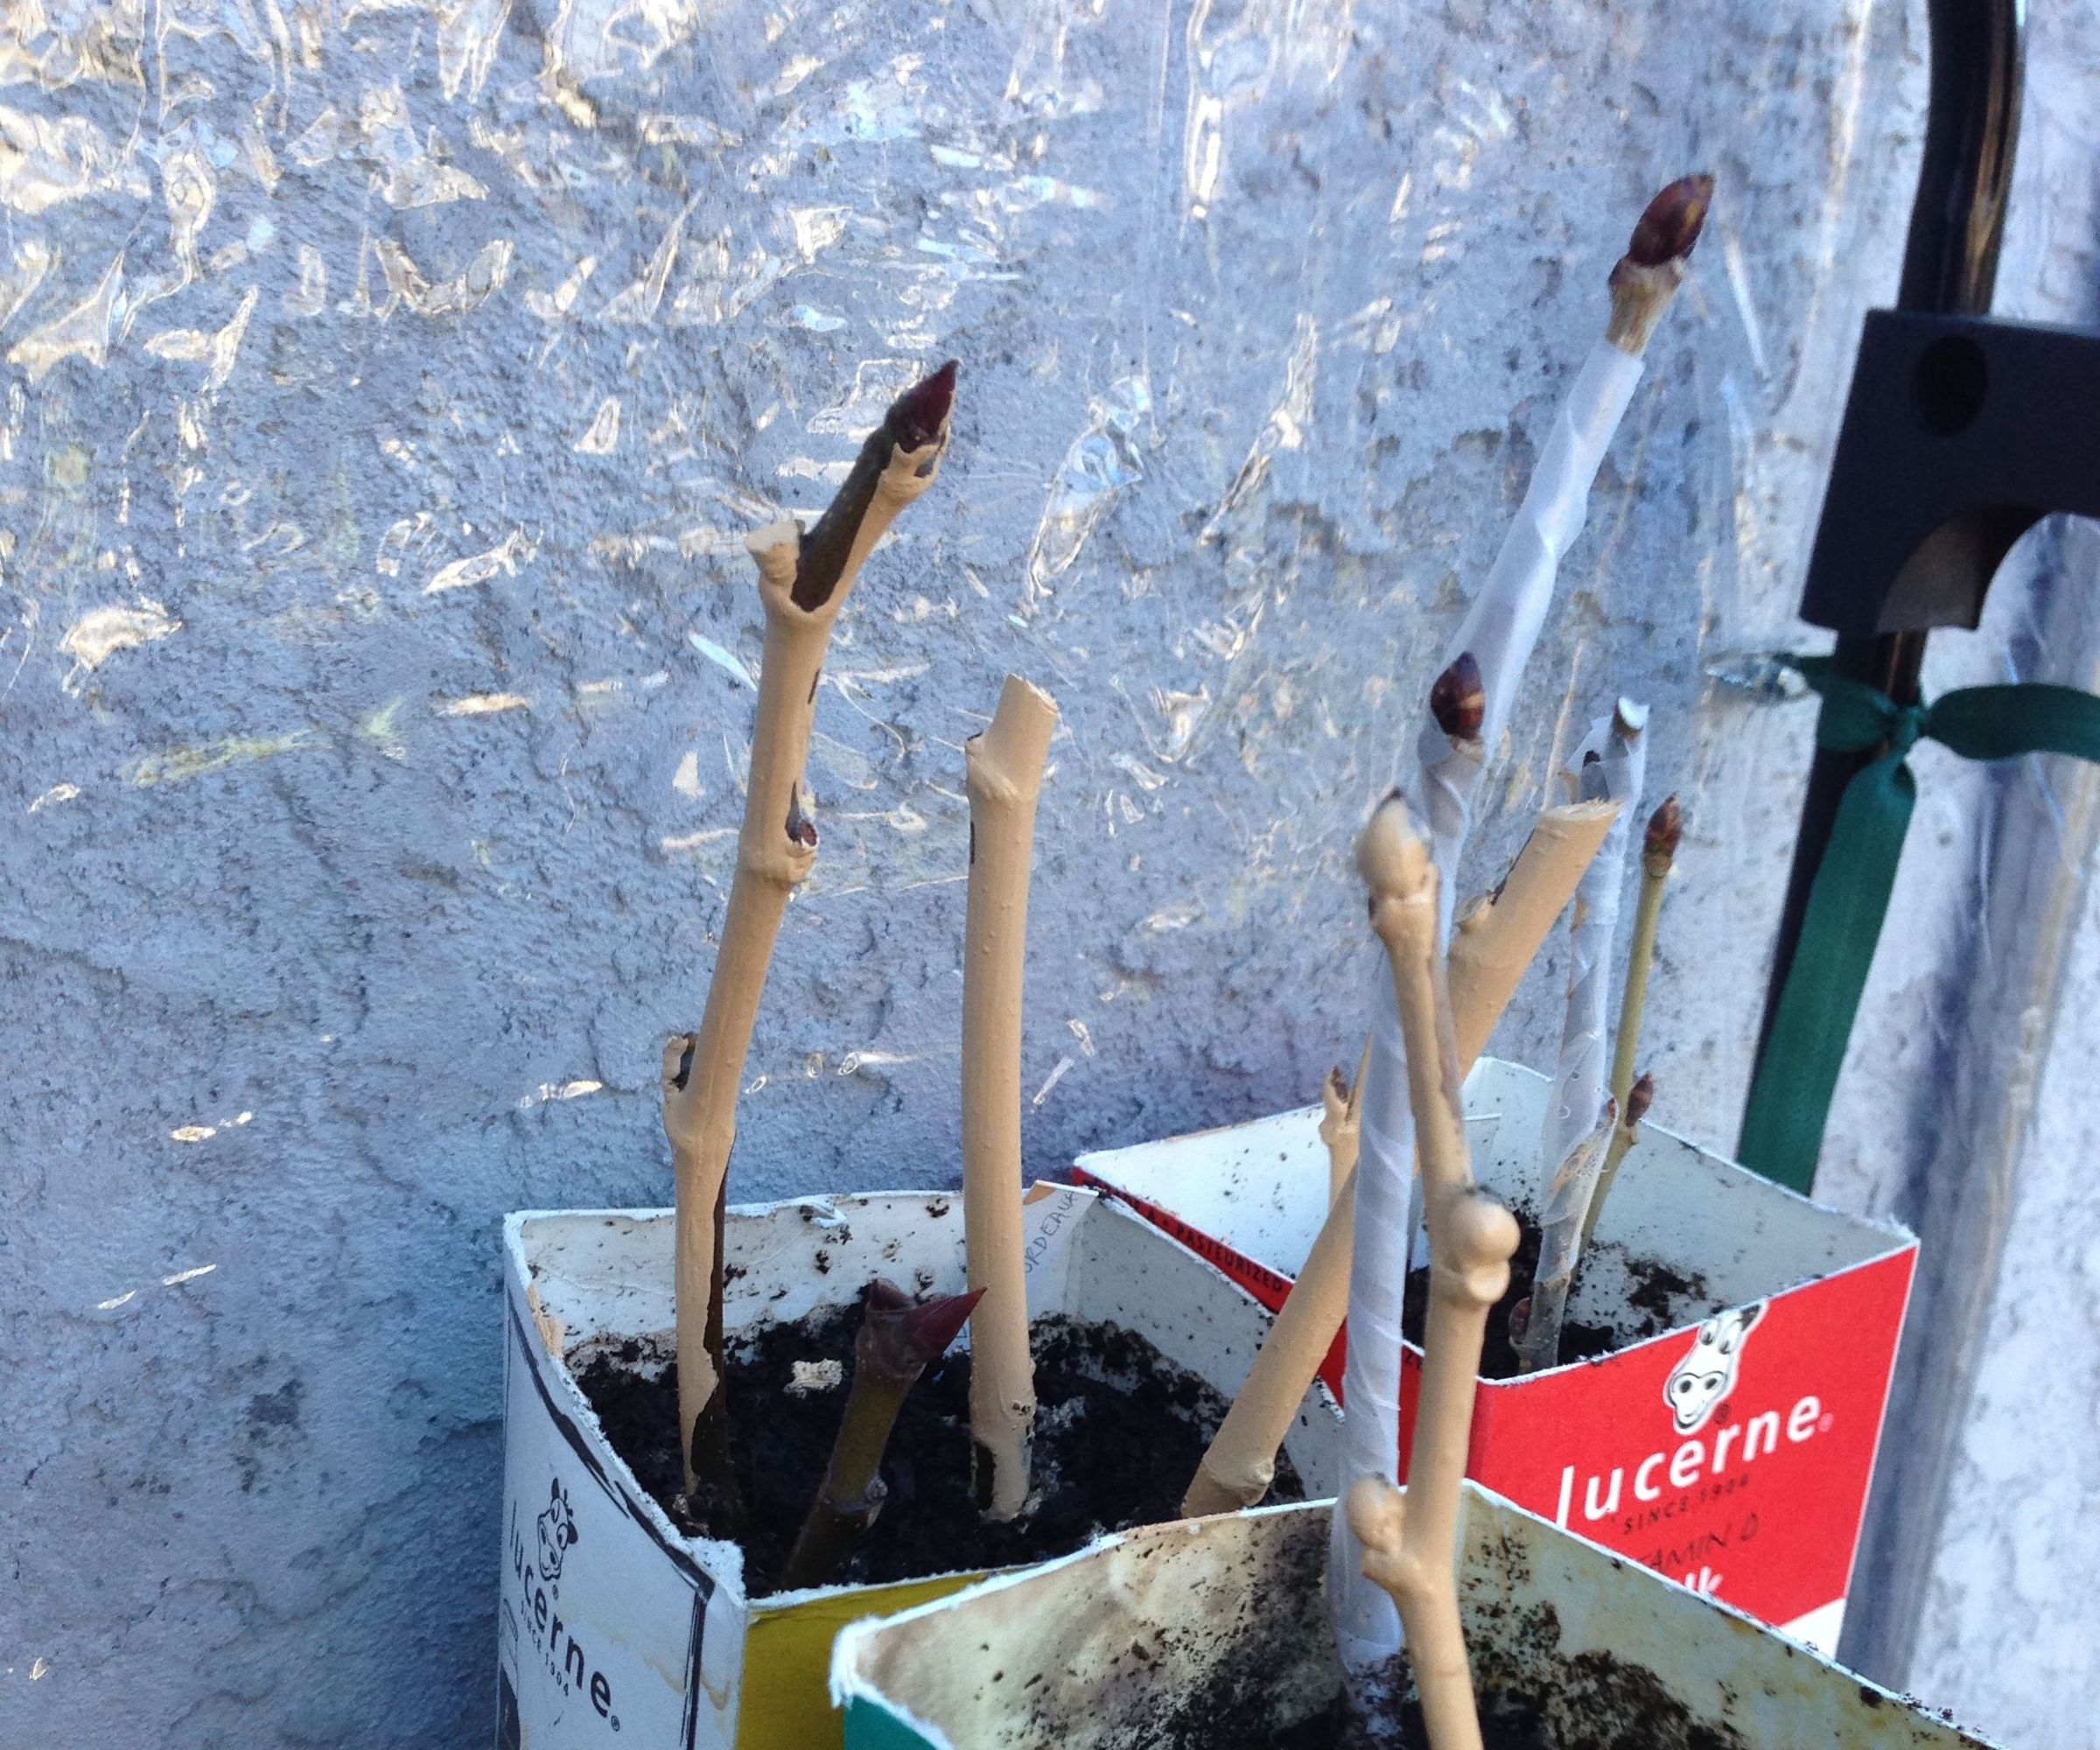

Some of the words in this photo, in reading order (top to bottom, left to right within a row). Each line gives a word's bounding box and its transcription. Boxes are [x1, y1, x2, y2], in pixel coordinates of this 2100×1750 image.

[1556, 1396, 1820, 1529] lucerne
[1624, 1495, 1689, 1535] SINCE
[509, 1499, 612, 1718] lucerne
